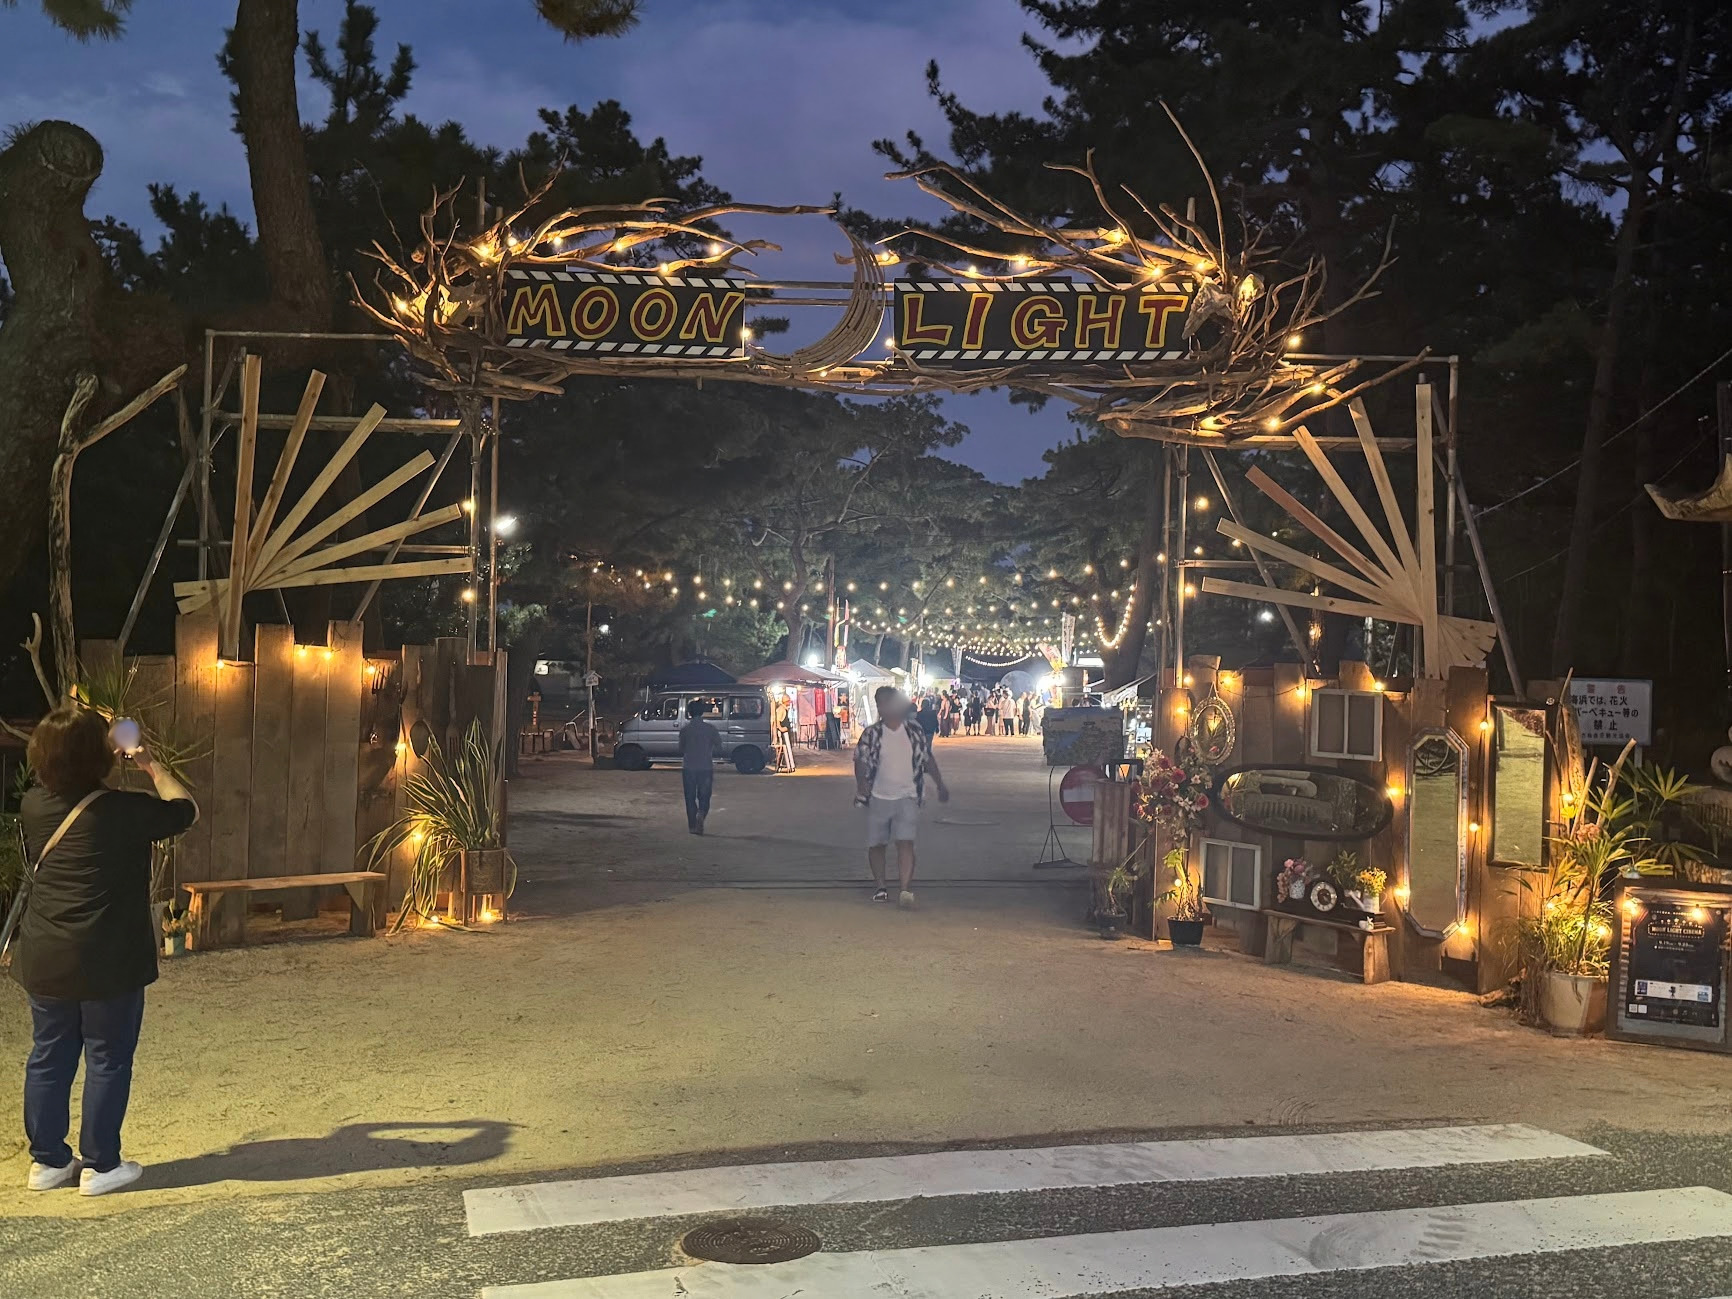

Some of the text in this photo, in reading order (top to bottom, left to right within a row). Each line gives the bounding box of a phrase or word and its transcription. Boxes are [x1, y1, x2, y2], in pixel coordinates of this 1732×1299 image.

[507, 283, 1189, 350] MOON LIGHT
[1593, 719, 1618, 731] 禁止
